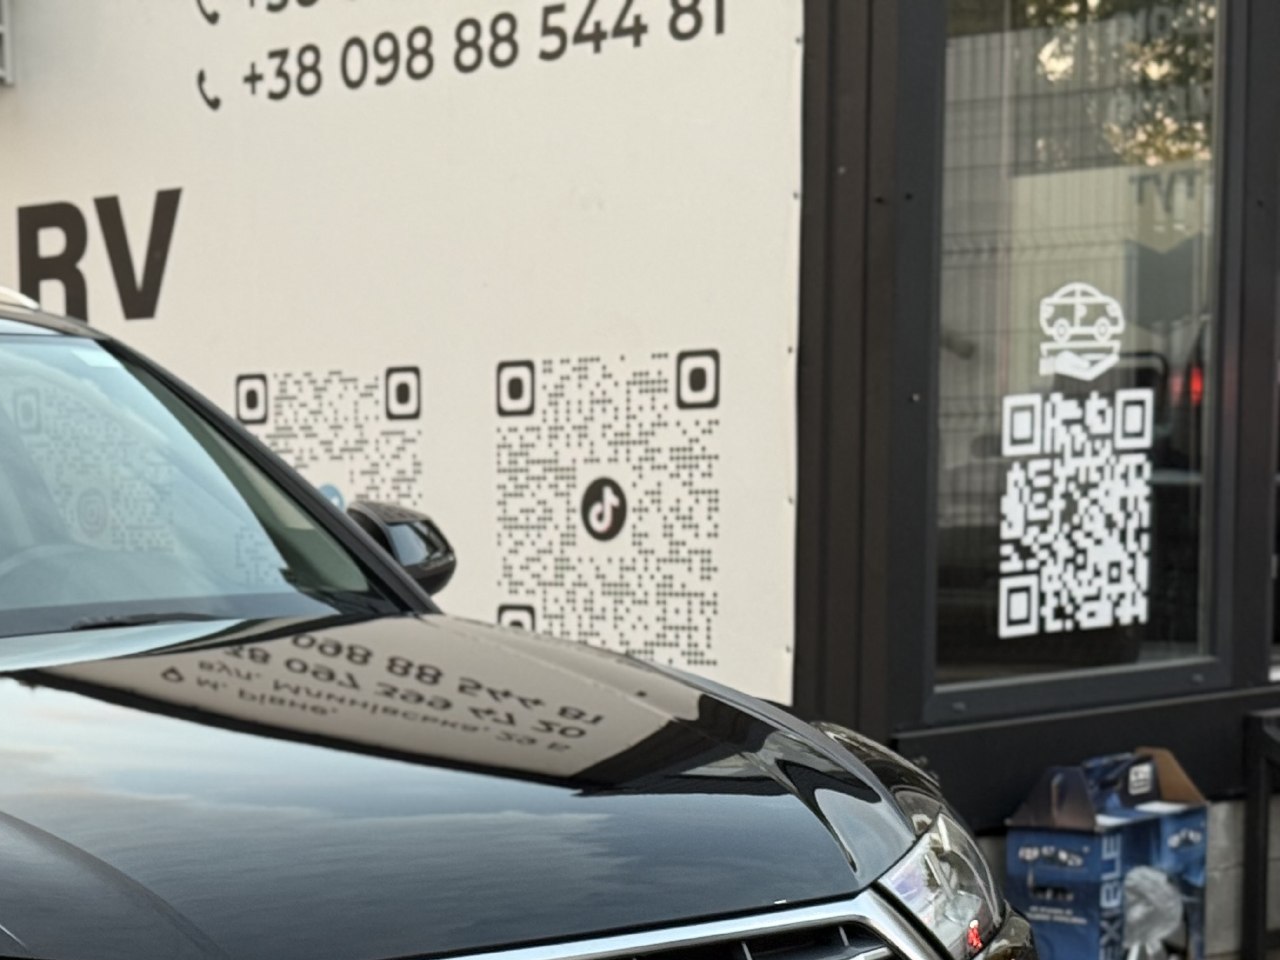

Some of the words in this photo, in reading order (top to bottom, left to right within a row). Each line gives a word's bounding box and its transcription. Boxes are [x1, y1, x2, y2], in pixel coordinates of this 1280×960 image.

[242, 43, 322, 101] +38
[340, 25, 435, 91] 098
[453, 11, 519, 74] 88
[538, 0, 648, 61] 544
[668, 0, 725, 41] 81
[17, 187, 183, 324] RV
